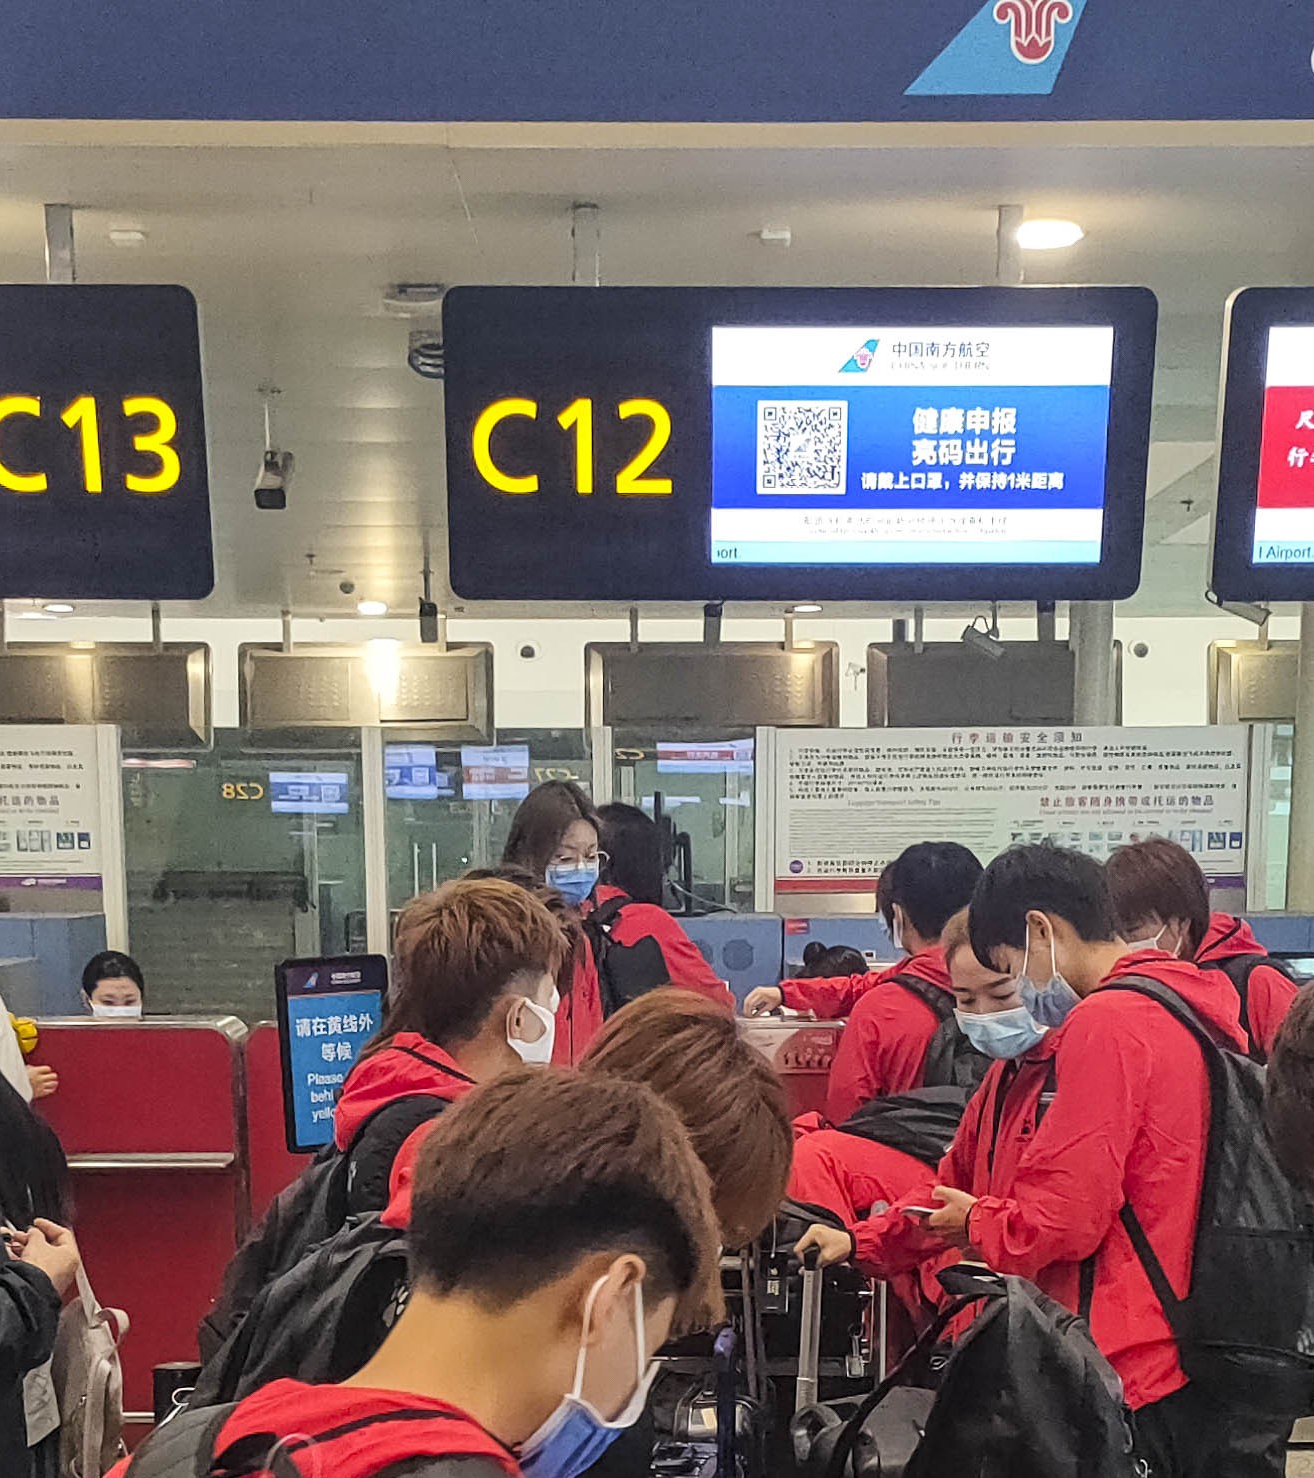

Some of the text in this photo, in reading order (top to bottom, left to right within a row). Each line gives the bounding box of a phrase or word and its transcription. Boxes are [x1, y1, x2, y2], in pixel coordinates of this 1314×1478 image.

[891, 340, 990, 358] 中国南方航空
[912, 406, 1017, 435] 健康申报
[470, 397, 675, 496] C12
[911, 438, 1016, 466] 亮码出行
[295, 1012, 374, 1038] 请在黄线外
[321, 1042, 353, 1062] 等候
